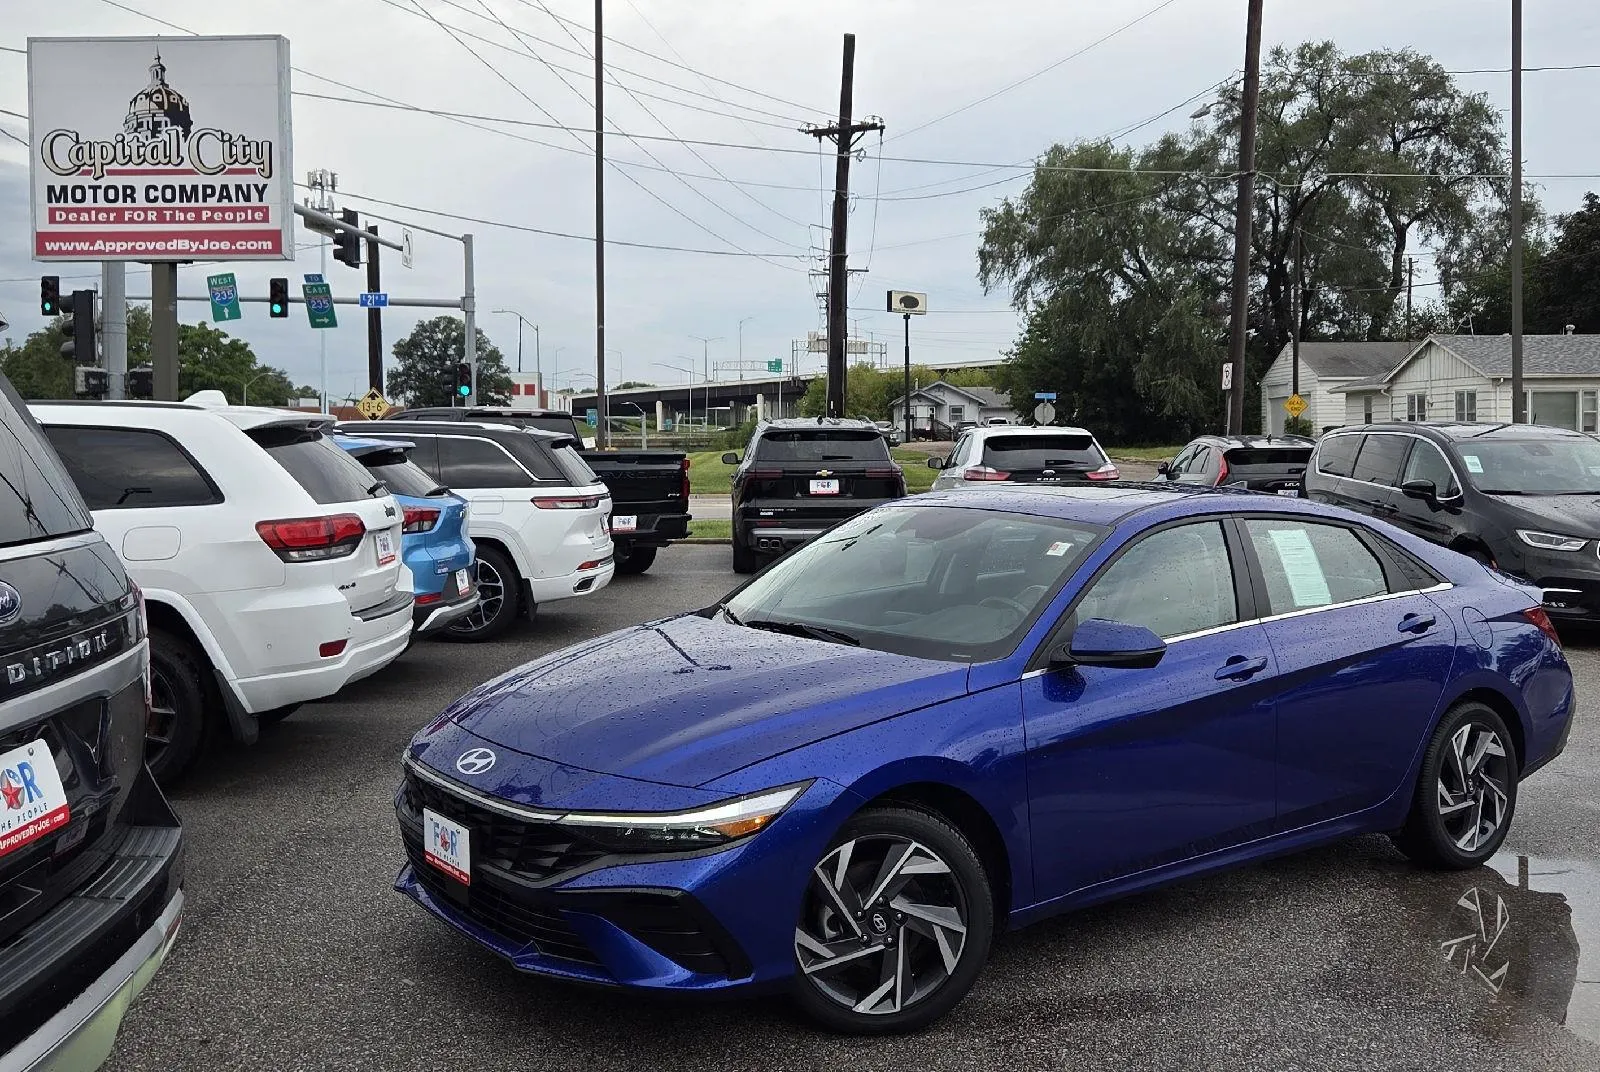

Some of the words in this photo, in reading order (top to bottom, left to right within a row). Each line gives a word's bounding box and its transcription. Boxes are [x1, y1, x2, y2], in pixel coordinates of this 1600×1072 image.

[41, 128, 184, 180] Capital
[188, 128, 273, 179] City
[46, 184, 137, 204] MOTOR
[144, 183, 268, 203] COMPANY
[55, 210, 117, 222] Dealer
[124, 210, 158, 222] FOR
[163, 209, 196, 221] The
[201, 209, 264, 223] People
[45, 238, 273, 253] www.ApprovedByJoe.com
[210, 276, 233, 286] WEST
[214, 290, 234, 301] 235
[305, 285, 327, 294] EAST
[311, 298, 330, 309] 235
[17, 802, 48, 823] PEOPLE
